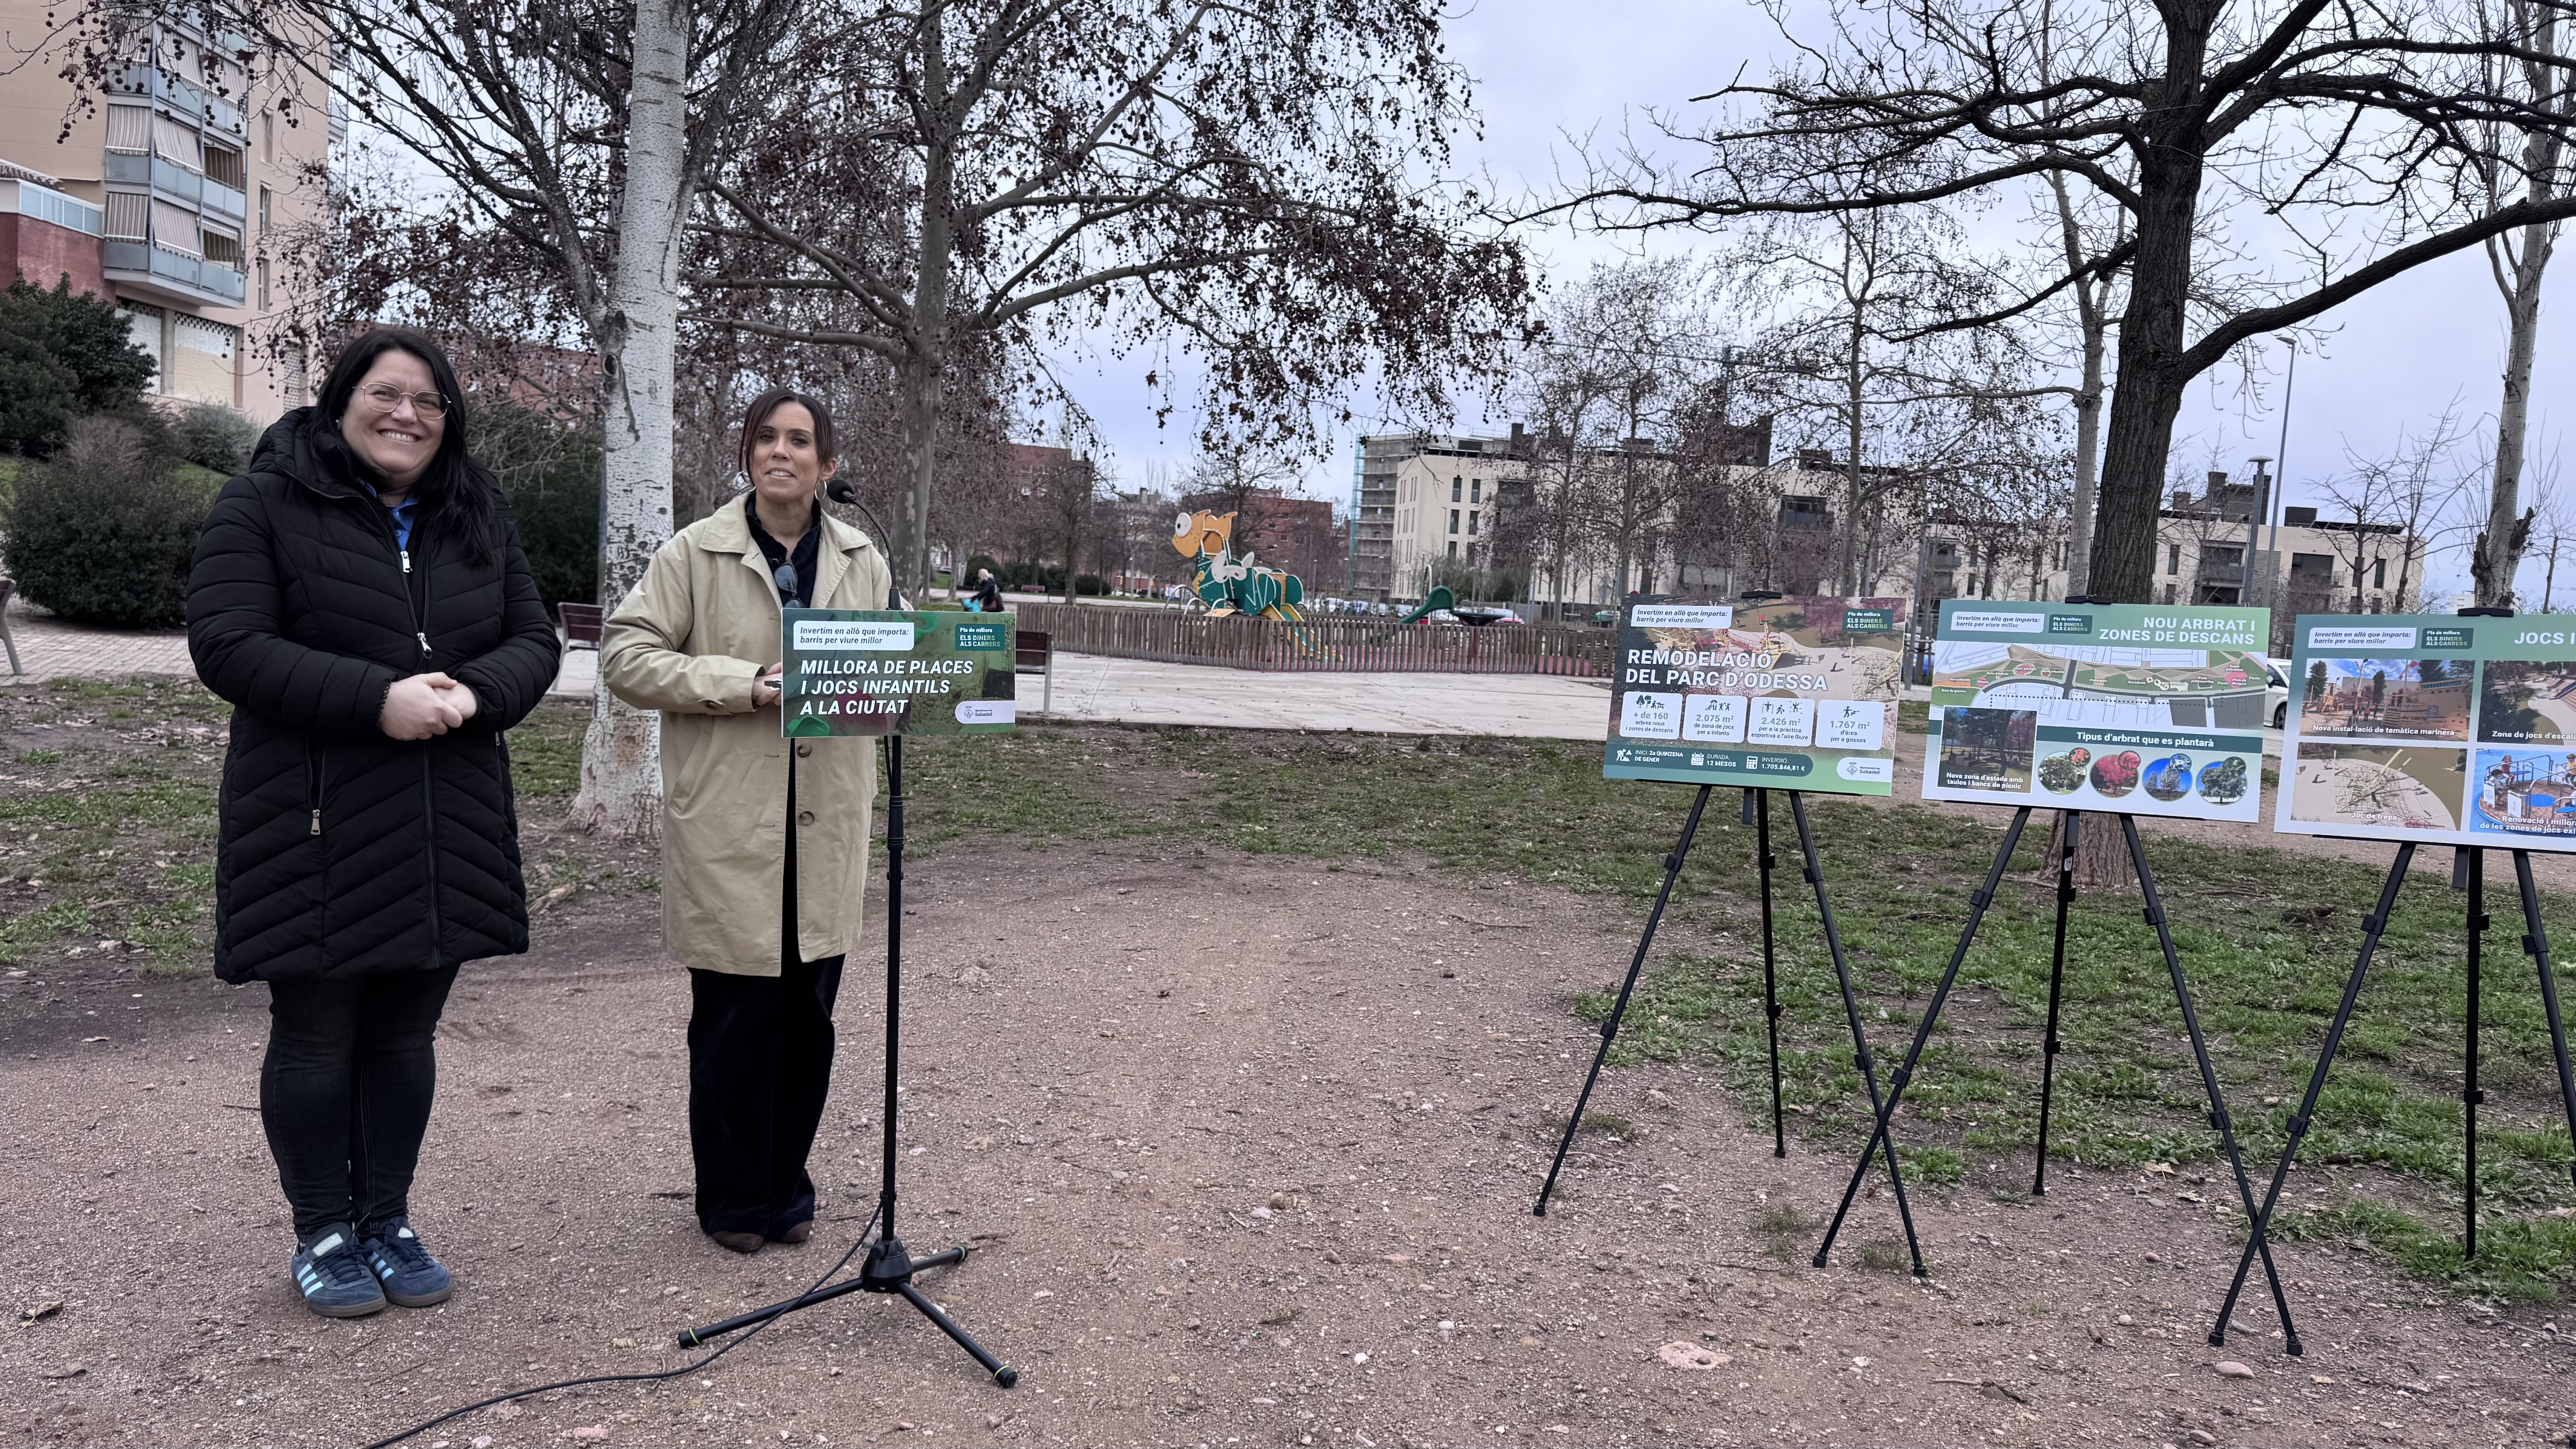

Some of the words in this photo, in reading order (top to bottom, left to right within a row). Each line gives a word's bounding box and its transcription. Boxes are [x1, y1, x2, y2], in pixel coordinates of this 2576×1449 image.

[2144, 617, 2177, 629] NOU
[2180, 619, 2246, 630] ARBRAT
[2251, 621, 2255, 631] I
[2099, 629, 2151, 641] ZONES
[2155, 631, 2175, 642] DE
[2179, 632, 2255, 644] DESCANS
[2514, 632, 2564, 644] JOCS
[1628, 649, 1772, 668] REMODELACIÓ
[800, 660, 879, 674] MILLORA
[883, 660, 906, 674] DE
[909, 660, 974, 674] PLACES
[1625, 668, 1661, 684] DEL
[1666, 670, 1721, 686] PARC
[800, 680, 807, 695] I
[811, 680, 858, 695] JOCS
[862, 680, 950, 694] INFANTILS
[800, 701, 813, 715] A
[818, 700, 840, 714] LA
[846, 699, 908, 714] CIUTAT
[2076, 732, 2102, 742] Tipus
[2142, 736, 2160, 745] que
[2175, 737, 2214, 747] plantarà
[2502, 816, 2544, 824] Renovació
